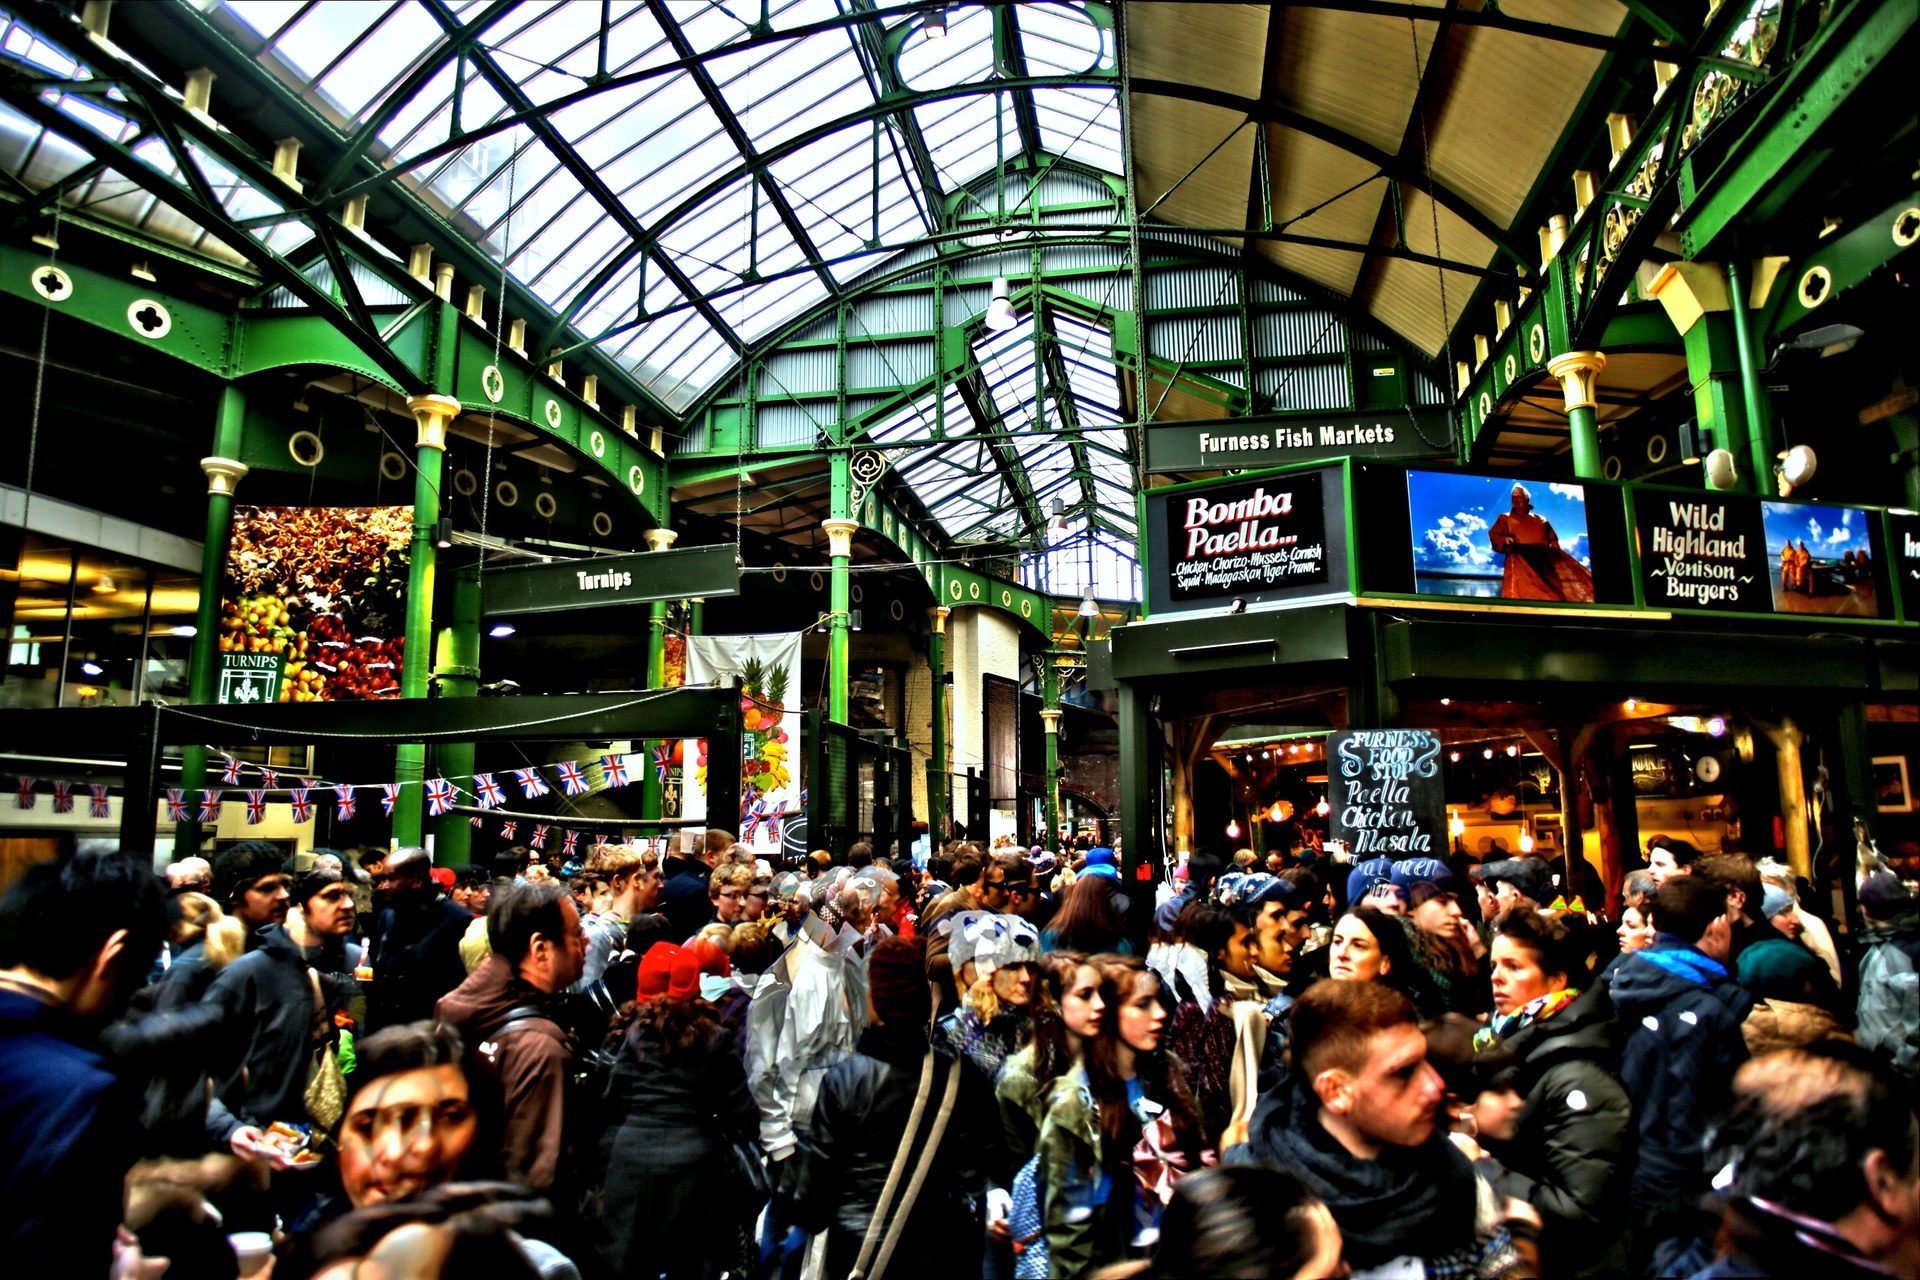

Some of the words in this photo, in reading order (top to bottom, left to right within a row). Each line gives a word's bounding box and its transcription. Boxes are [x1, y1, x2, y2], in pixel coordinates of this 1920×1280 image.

[1200, 433, 1270, 452] Furness
[1276, 427, 1314, 448] Fish
[1319, 424, 1395, 446] Markets
[1184, 488, 1293, 529] Bomba
[1669, 501, 1725, 531] Wild
[1652, 526, 1746, 560] Highland
[576, 569, 632, 590] Turnips
[1205, 566, 1261, 589] Madagaskan
[1262, 564, 1286, 583] Tiger
[1664, 557, 1735, 580] Venison
[1666, 576, 1739, 605] Burgers
[223, 654, 278, 669] TURNIPS
[1350, 730, 1432, 748] FURNESS
[1367, 747, 1415, 766] FOOD
[1371, 762, 1415, 781] STOP
[1345, 778, 1410, 804] Paella
[1341, 803, 1416, 829] Chicken
[1355, 826, 1431, 853] Masala
